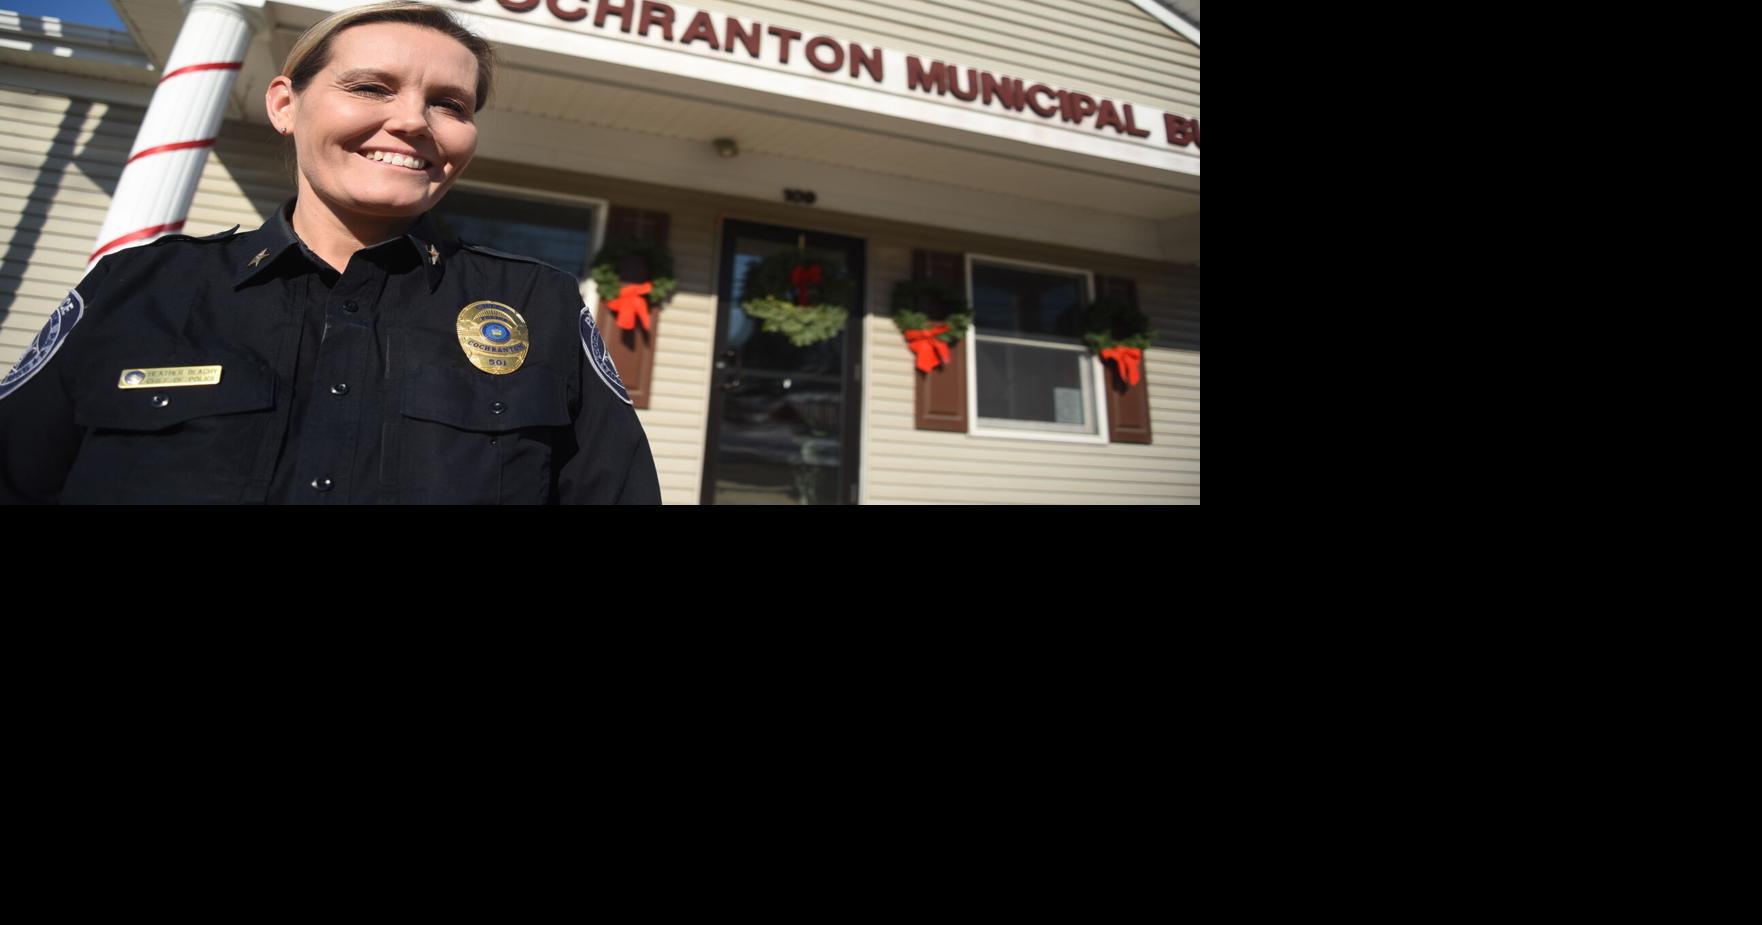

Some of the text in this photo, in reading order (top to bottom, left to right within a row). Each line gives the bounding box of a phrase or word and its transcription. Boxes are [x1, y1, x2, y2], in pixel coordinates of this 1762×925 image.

[455, 0, 884, 83] CHRANTON
[906, 55, 1151, 138] MUNICIPAL
[468, 339, 525, 353] COCHRANTON
[488, 358, 507, 366] 501
[147, 369, 184, 378] HEATHER
